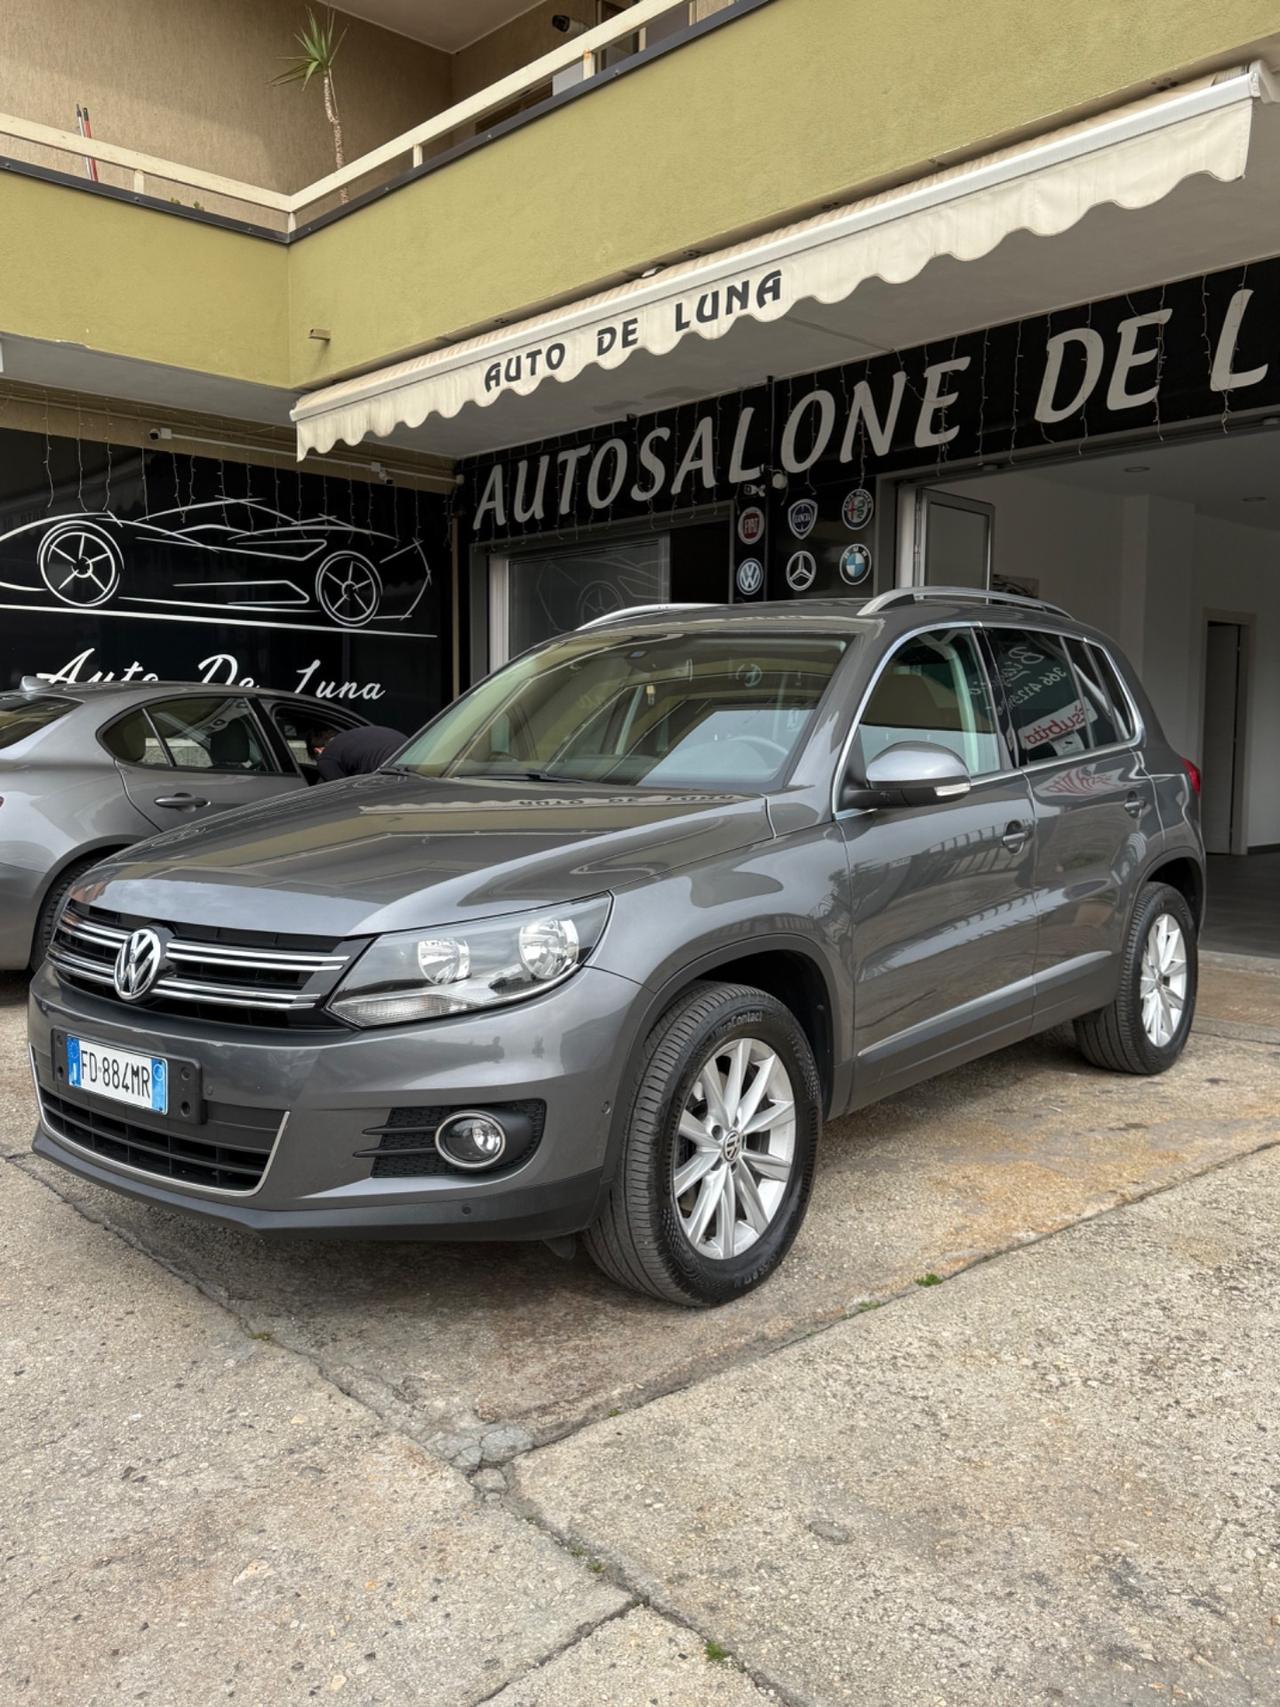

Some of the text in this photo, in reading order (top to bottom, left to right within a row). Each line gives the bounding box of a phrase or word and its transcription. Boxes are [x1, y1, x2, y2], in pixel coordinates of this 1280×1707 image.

[484, 270, 782, 392] AUTO DE LUNA
[473, 356, 971, 531] AUTOSALONE
[1034, 309, 1173, 423] DE
[745, 518, 758, 534] FIAT
